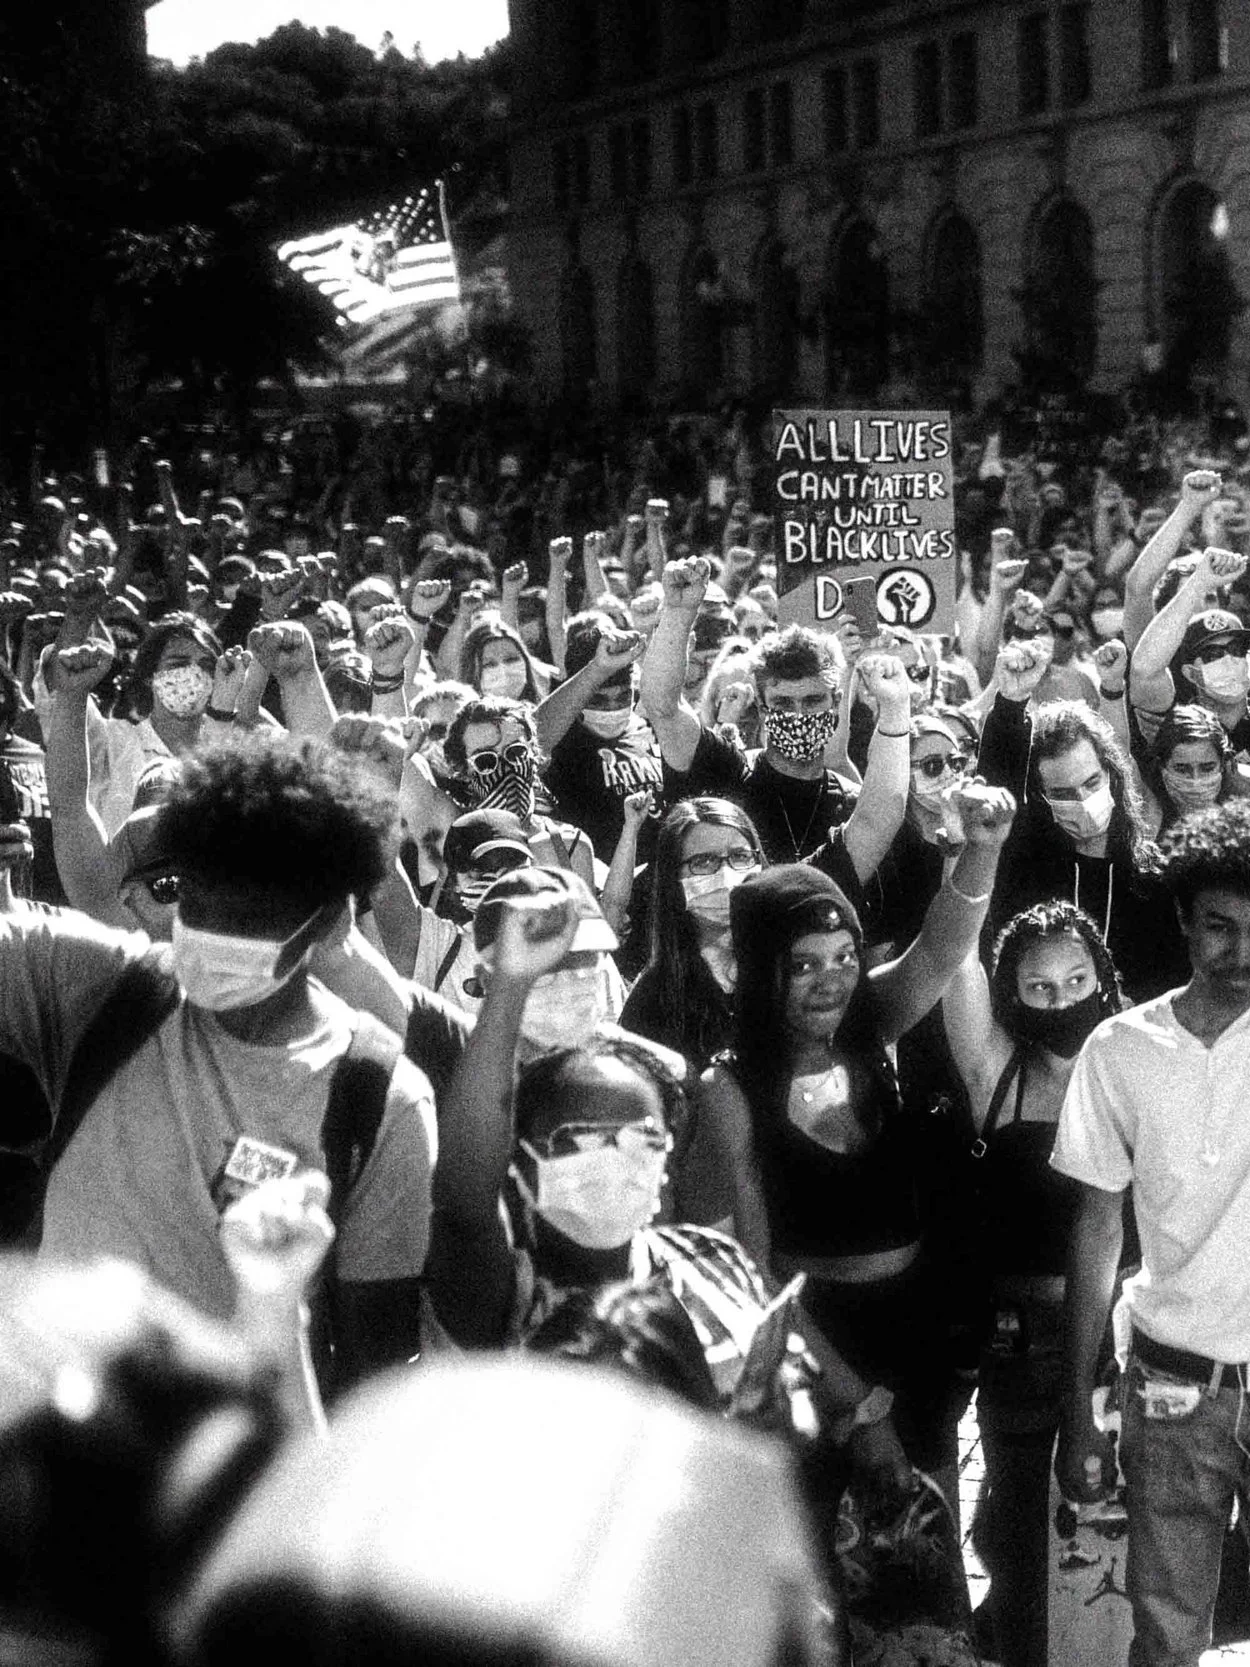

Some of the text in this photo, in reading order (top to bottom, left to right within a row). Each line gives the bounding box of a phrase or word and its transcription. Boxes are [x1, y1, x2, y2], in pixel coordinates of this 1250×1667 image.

[776, 420, 949, 463] ALL LIVES
[776, 470, 946, 501] CANT MATTER
[834, 502, 920, 528] UNTIL
[784, 520, 954, 563] BLACK LIVES
